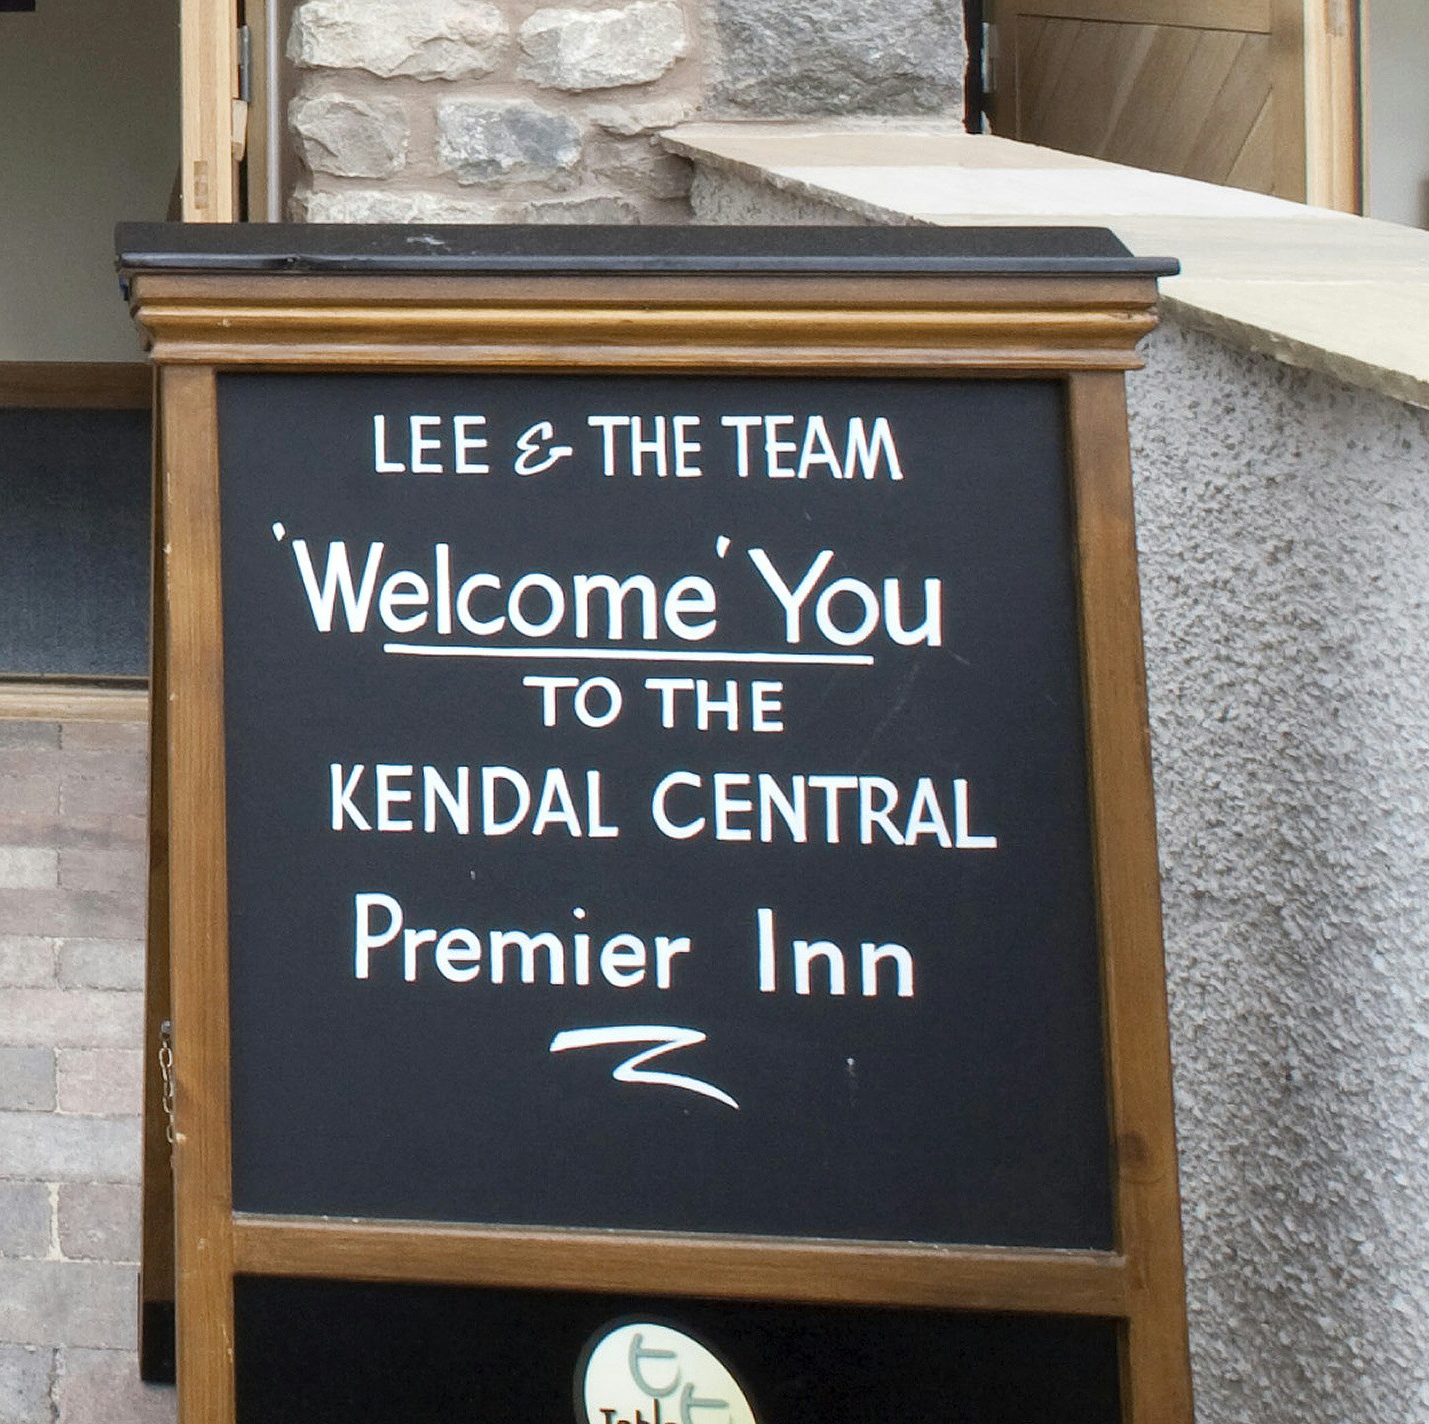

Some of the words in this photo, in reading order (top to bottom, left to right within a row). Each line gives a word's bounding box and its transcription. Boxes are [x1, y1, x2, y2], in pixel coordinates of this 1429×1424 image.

[373, 414, 490, 474] LEE
[514, 421, 574, 477] &
[587, 415, 703, 478] THE
[720, 414, 904, 481] TEAM
[747, 548, 943, 647] You
[522, 675, 623, 728] TO
[644, 678, 784, 732] THE
[330, 763, 620, 839] KENDAL
[651, 771, 998, 850] CENTRAL
[355, 892, 691, 990] Premier
[757, 907, 914, 998] Inn
